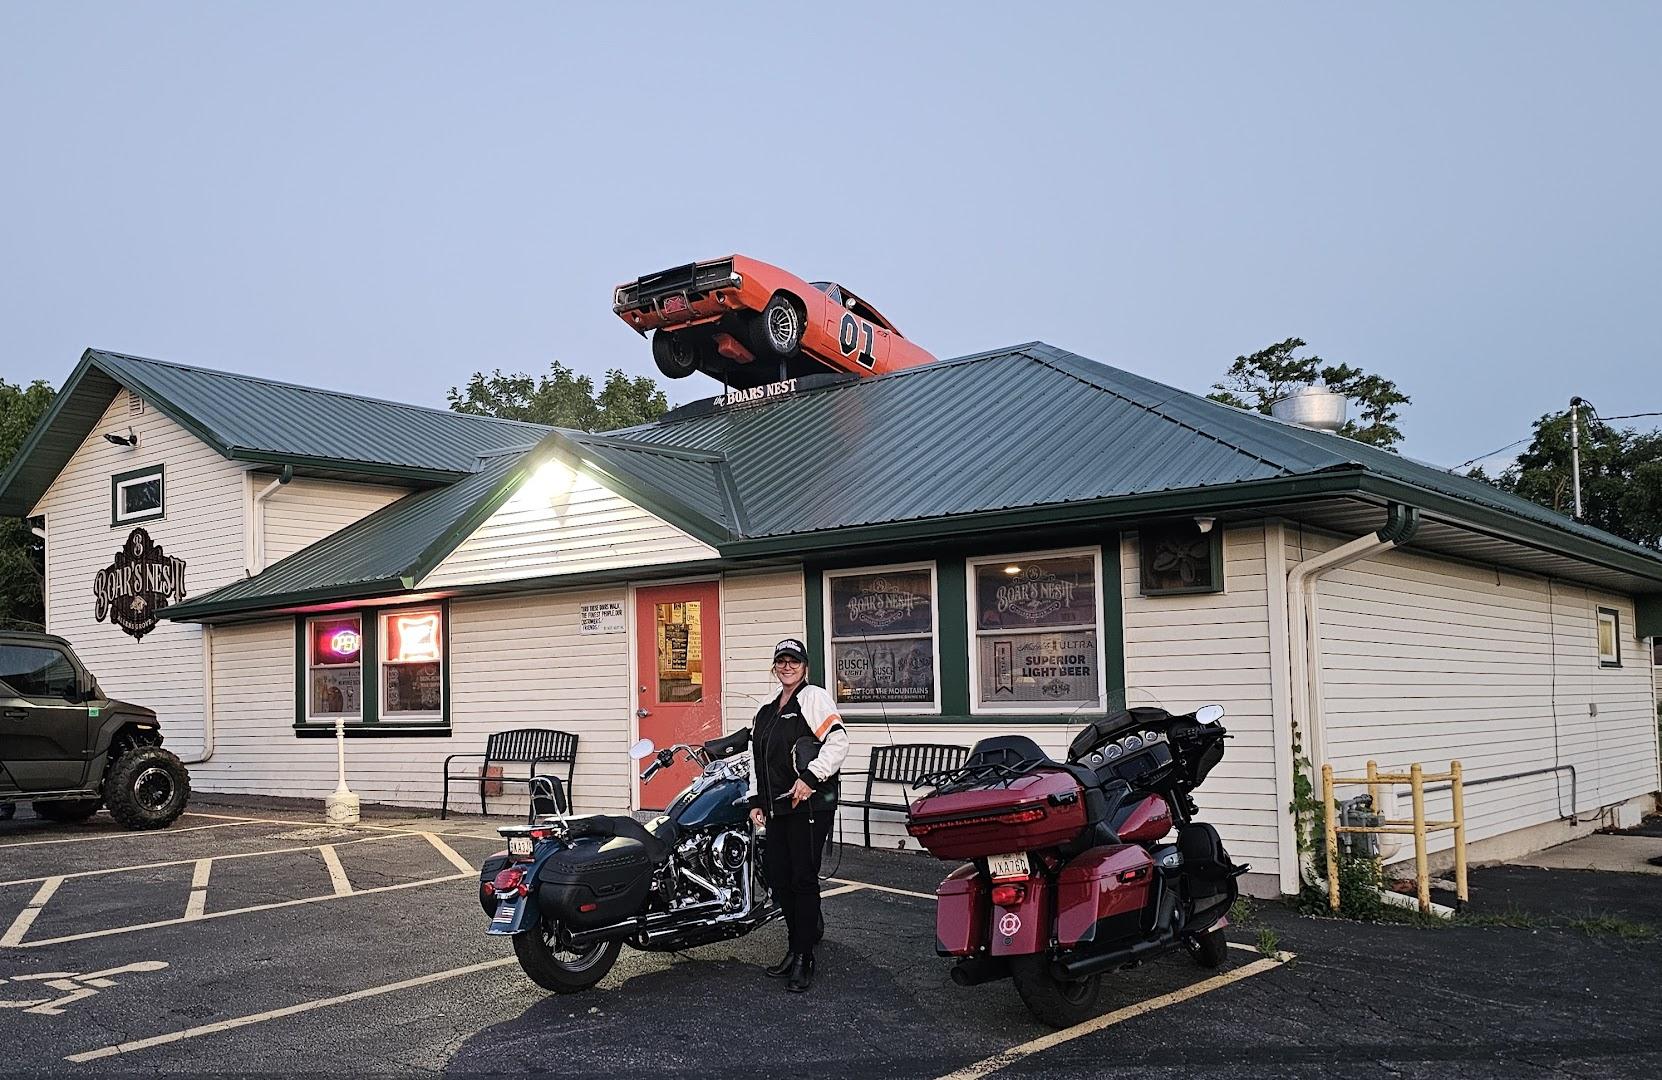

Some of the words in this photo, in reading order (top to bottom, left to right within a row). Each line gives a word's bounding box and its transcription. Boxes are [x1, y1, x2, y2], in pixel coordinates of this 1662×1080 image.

[839, 311, 876, 370] 01
[713, 396, 725, 406] the
[727, 386, 764, 405] BOARS
[766, 378, 797, 397] NEST
[94, 561, 143, 621] BOAR'S
[146, 556, 186, 604] NEST
[997, 581, 1038, 612] BOAR'S
[1040, 580, 1074, 608] NEST
[848, 593, 884, 621] BOAR'S
[885, 592, 914, 616] NEST
[1060, 641, 1094, 649] ULTRA
[838, 659, 869, 670] BUSCH
[1025, 655, 1086, 666] SUPERIOR
[873, 666, 894, 676] BUSCH
[1022, 667, 1057, 677] LIGHT
[1059, 667, 1090, 676] BEER
[888, 687, 928, 695] MOUNTAINS
